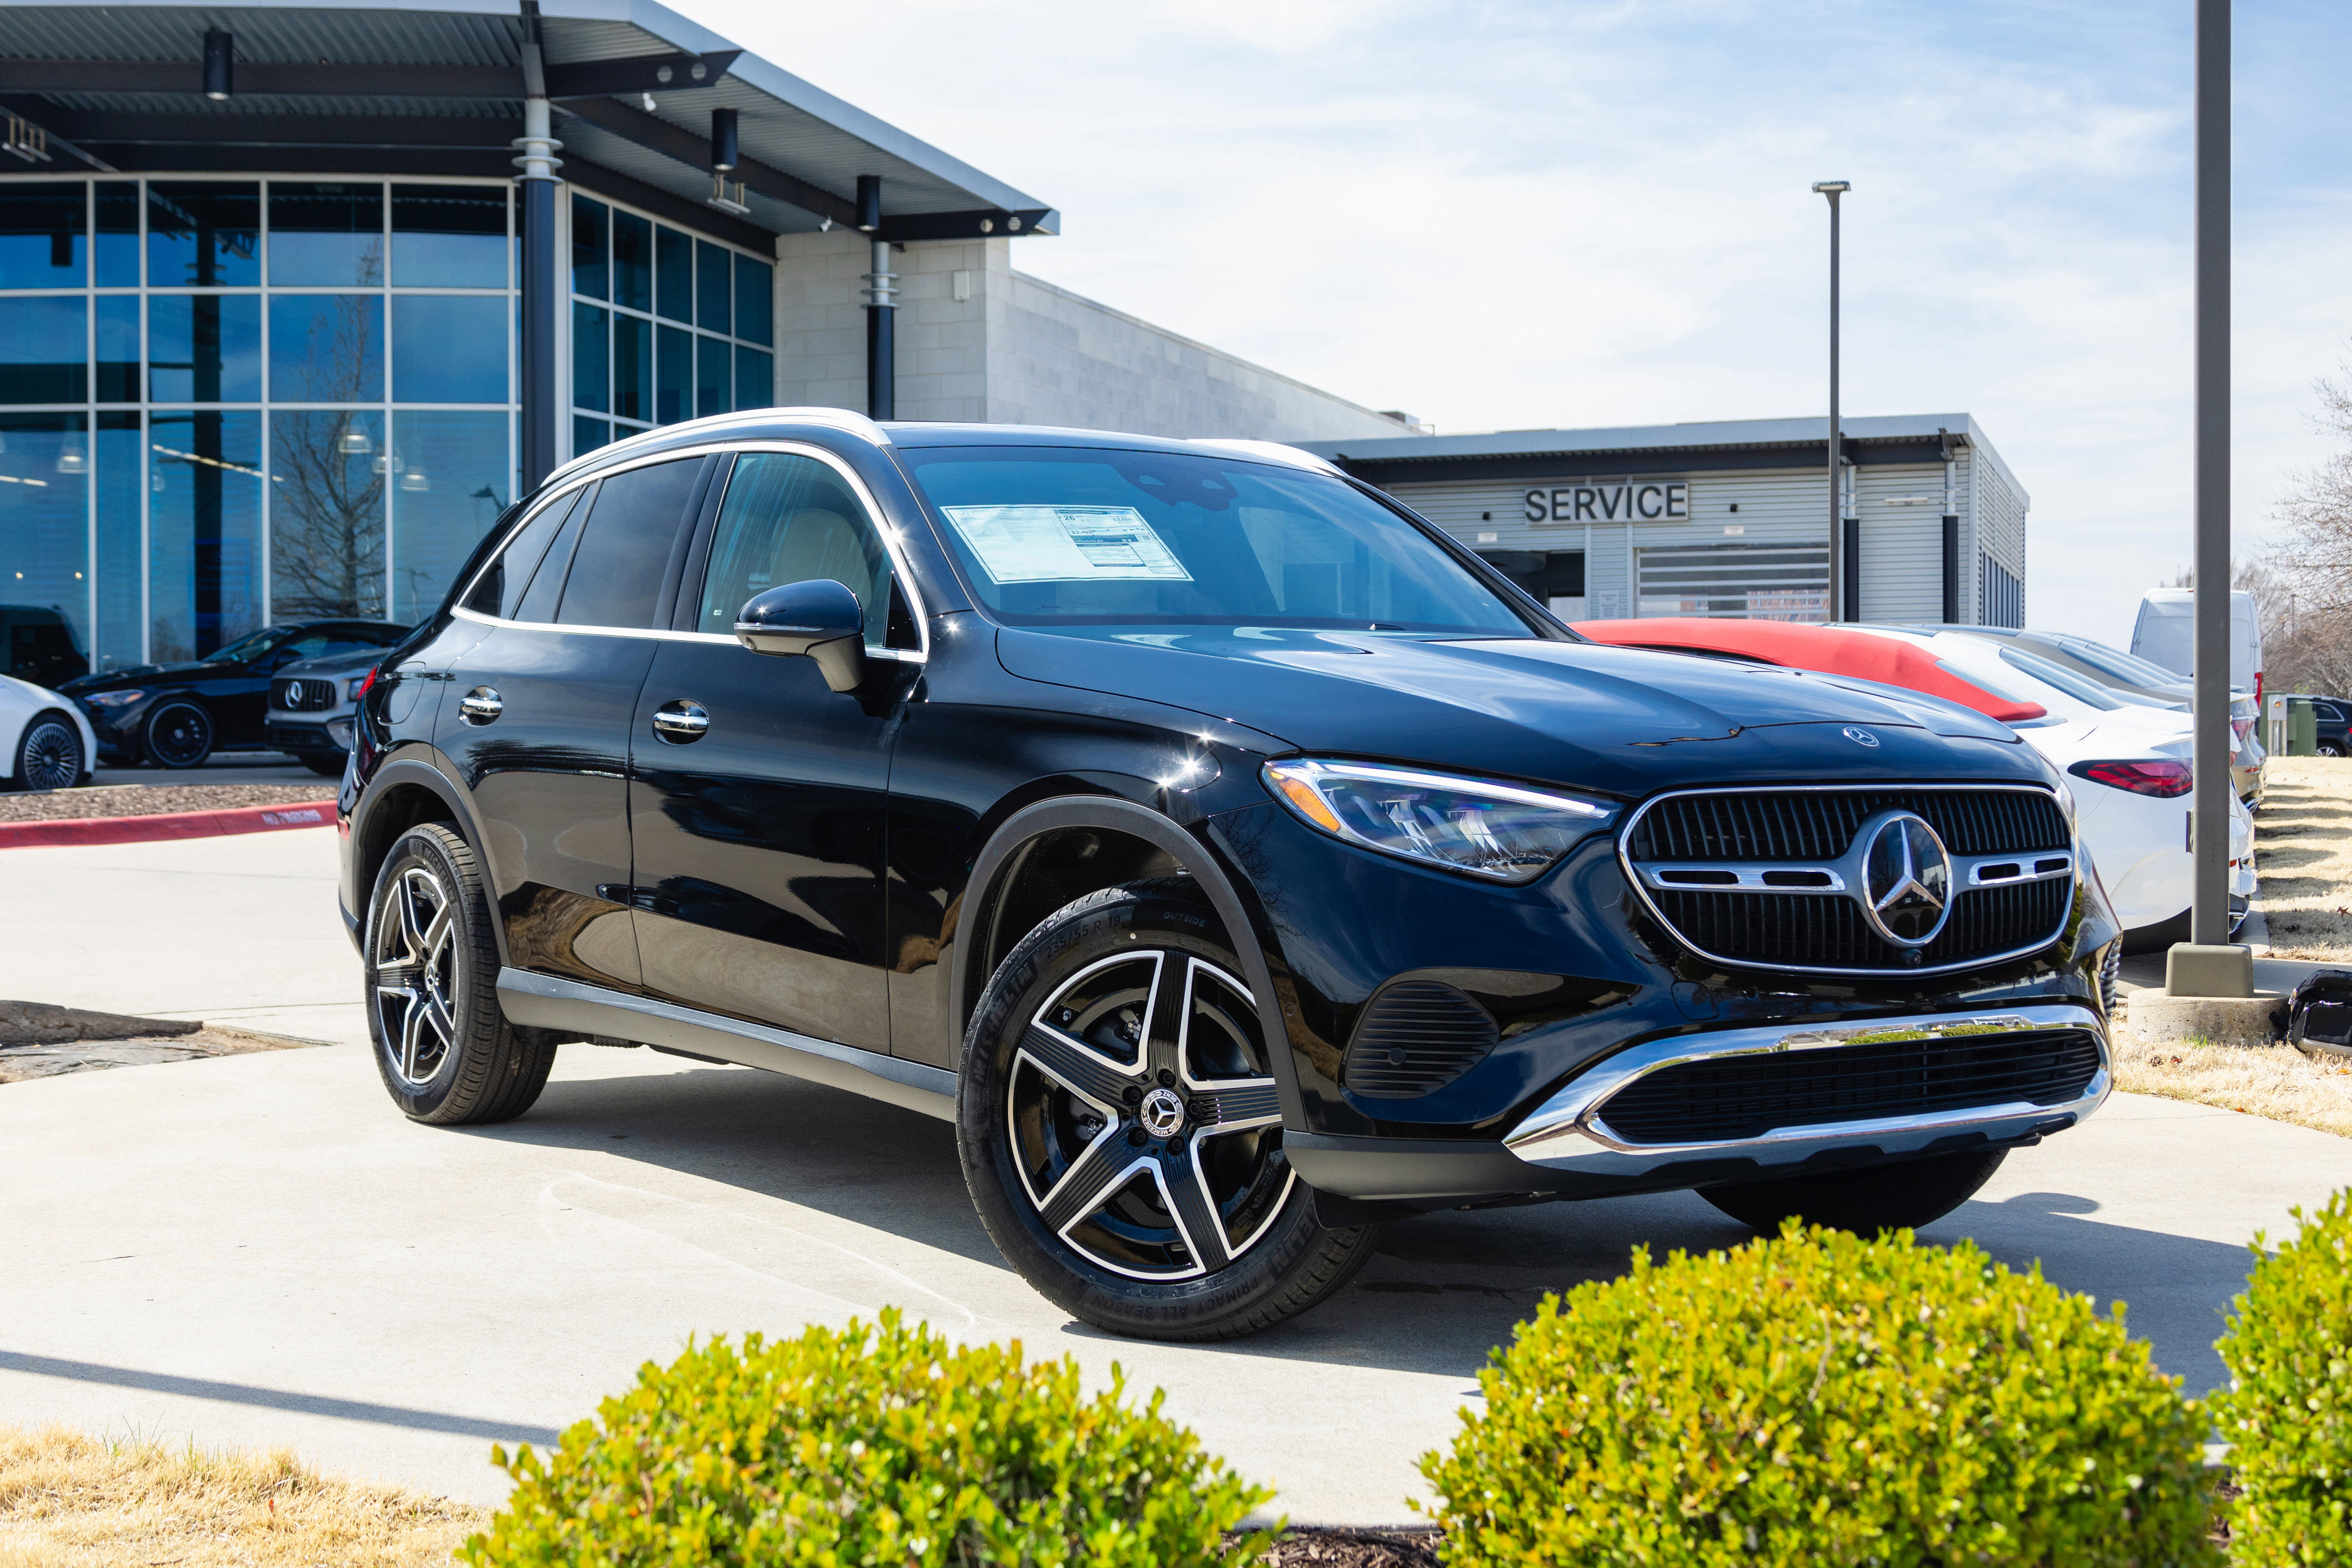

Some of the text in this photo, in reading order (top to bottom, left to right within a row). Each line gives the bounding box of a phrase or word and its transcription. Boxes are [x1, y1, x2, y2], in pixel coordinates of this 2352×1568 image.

[1526, 485, 1686, 522] SERVICE
[262, 809, 321, 826] NO PARKING
[423, 847, 455, 904] MICHELIN
[1163, 911, 1207, 927] OUTSIDE
[1045, 915, 1121, 959] 235/55 R 19
[974, 962, 1032, 1083] MICHELIN
[1163, 1091, 1177, 1103] BENZ
[1143, 1116, 1168, 1135] MERCEDES
[1091, 1294, 1153, 1318] SEASON
[1196, 1277, 1259, 1313] PRIMACY
[1161, 1305, 1188, 1319] ALL
